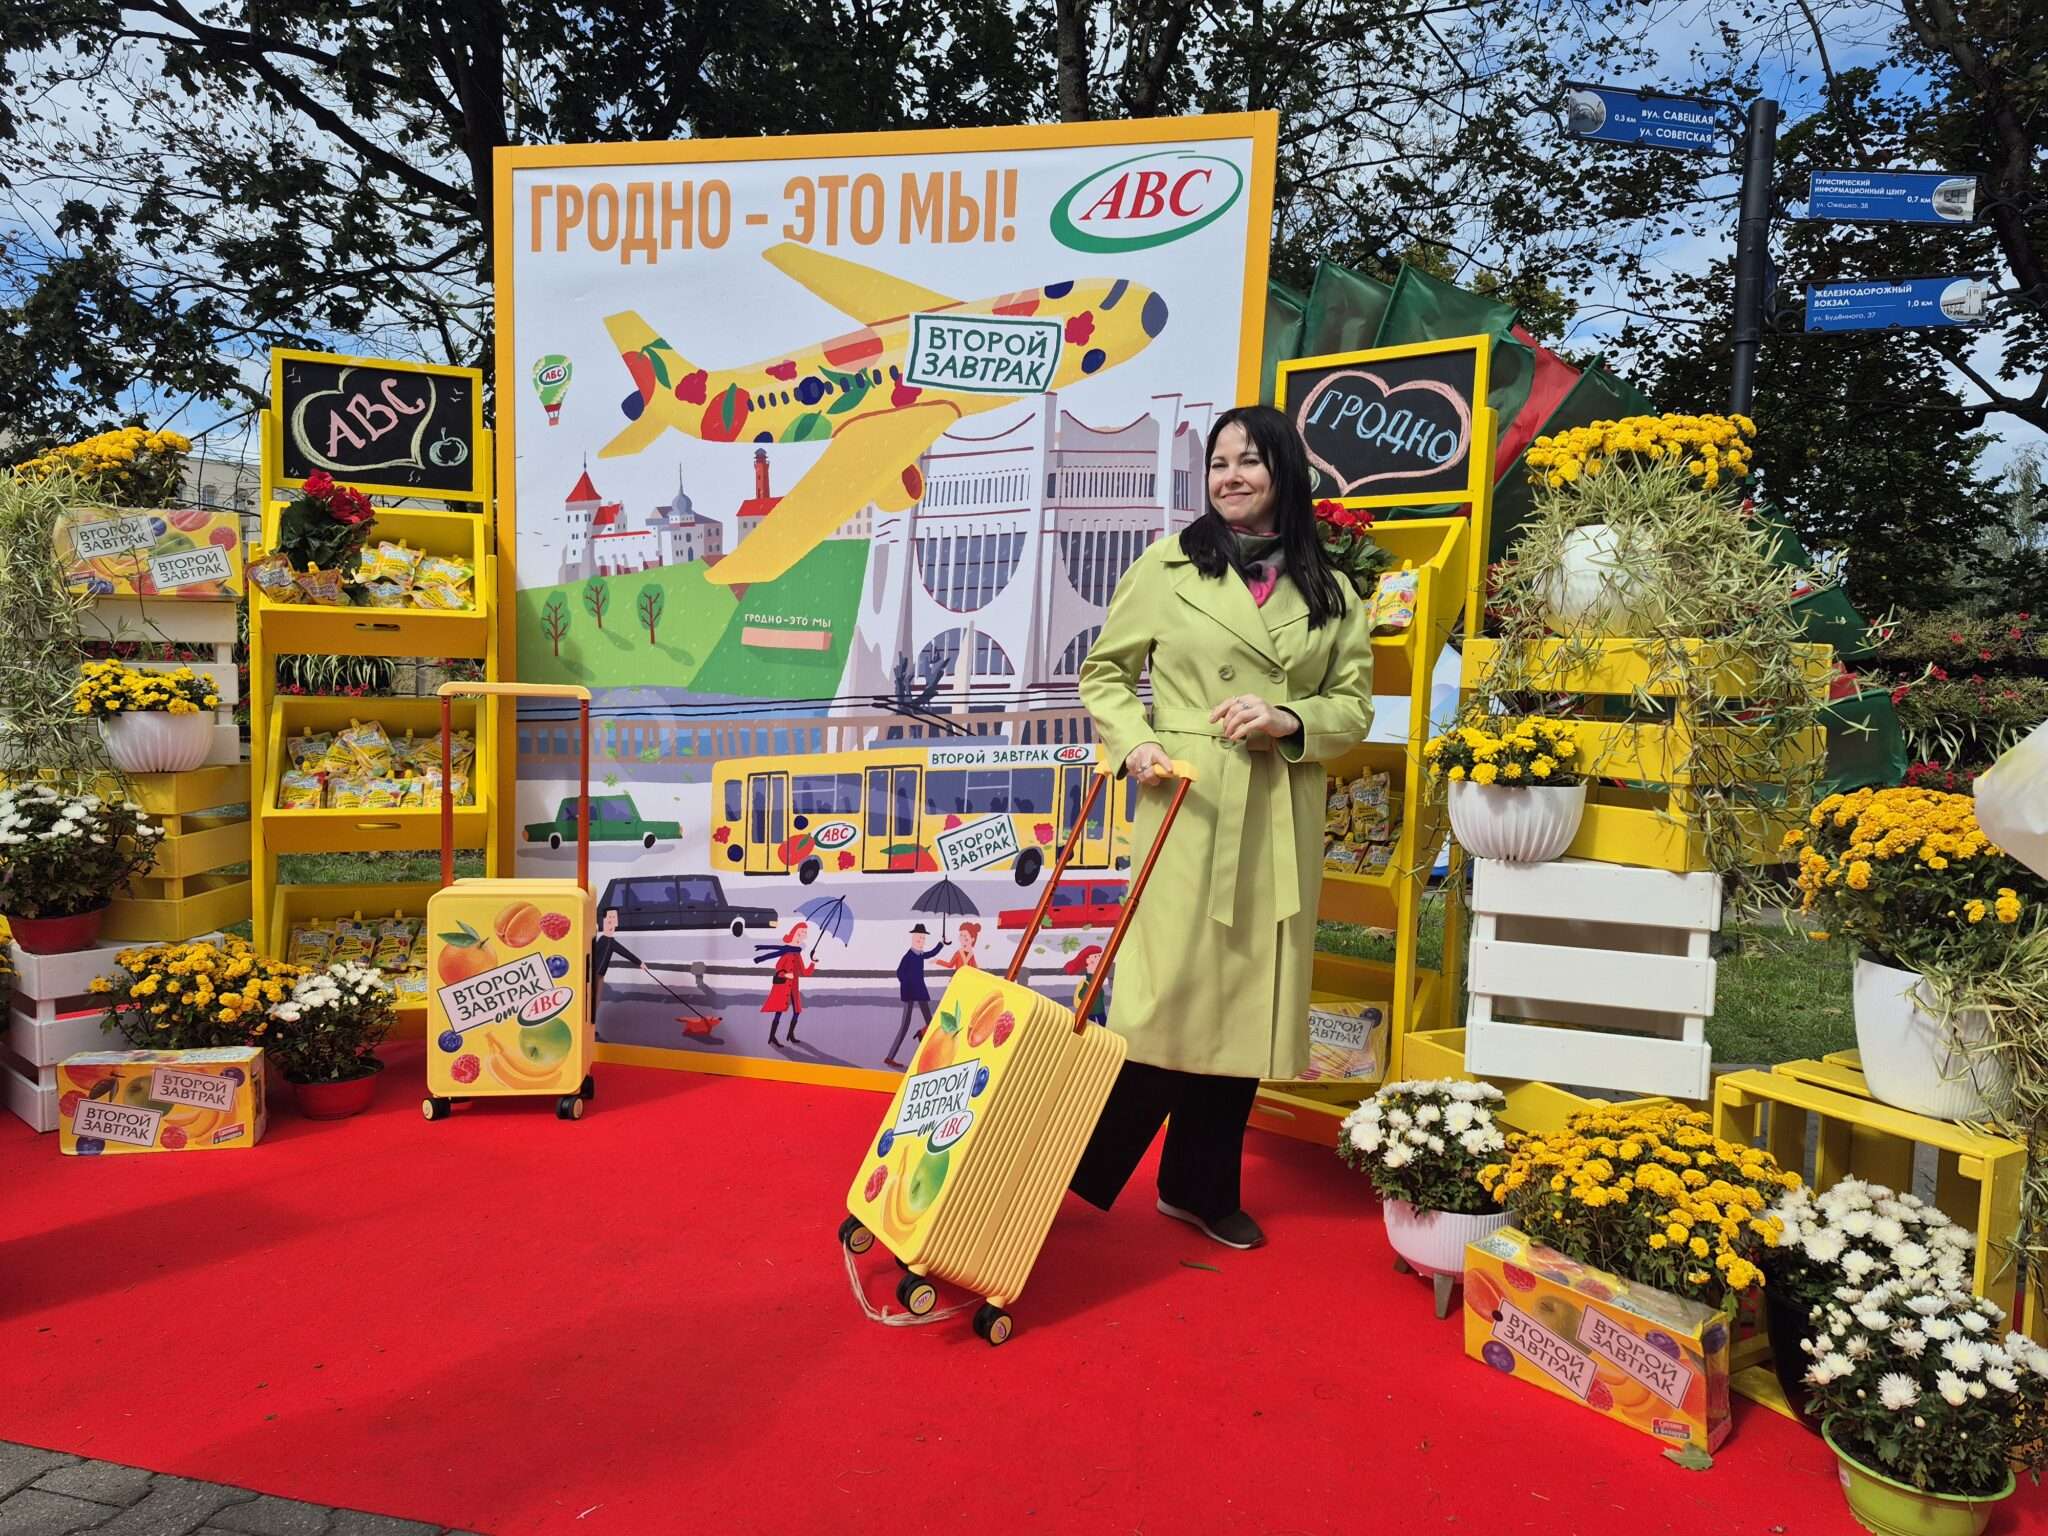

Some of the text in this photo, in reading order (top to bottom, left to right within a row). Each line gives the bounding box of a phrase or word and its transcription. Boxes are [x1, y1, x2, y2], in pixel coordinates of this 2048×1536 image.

[1641, 109, 1714, 124] вул. САВЕЦКАЯ
[1639, 127, 1712, 143] ул. СОВЕТСКАЯ
[1814, 186, 1906, 196] ИНФОРМАЦИОННЫЙ ЦЕНТР
[1815, 178, 1871, 187] ТУРИСТИЧЕСКИЙ
[1906, 196, 1919, 204] 0,7
[530, 178, 730, 265] ГРОДНО
[782, 171, 885, 246] ЭТО
[900, 168, 1018, 245] МЫ!
[1814, 285, 1912, 298] ЖЕЛЕЗНОДОРОЖНЫЙ
[1813, 299, 1850, 308] ВОКЗАЛ
[1907, 299, 1920, 308] 1,0
[929, 325, 1050, 358] ВТОРОЙ
[921, 353, 1045, 386] ЗАВТРАК
[1307, 389, 1458, 463] ГРОДНО
[79, 518, 141, 542] ВТОРОЙ
[82, 532, 149, 553] ЗАВТРАК
[158, 551, 219, 573] ВТОРОЙ
[161, 563, 225, 584] ЗАВТРАК
[812, 618, 832, 628] МЫ
[931, 750, 985, 765] ВТОРОЙ
[992, 749, 1049, 763] ЗАВТРАК
[948, 821, 1007, 856] ВТОРОЙ
[951, 836, 1012, 871] ЗАВТРАК
[452, 959, 537, 1006] ВТОРОЙ
[457, 978, 547, 1022] ЗАВТРАК
[494, 1004, 520, 1024] от
[1308, 1015, 1364, 1034] ВТОРОЙ
[1310, 1028, 1361, 1044] АВТРАК
[163, 1074, 226, 1093] ВТОРОЙ
[911, 1066, 970, 1101] ВТОРОЙ
[159, 1085, 225, 1105] ЗАВТРАК
[86, 1107, 151, 1127] ВТОРОЙ
[903, 1092, 964, 1122] ЗАВТРАК
[81, 1119, 149, 1140] ЗАВТРАК
[1509, 1313, 1585, 1373] ВТОРОЙ
[1595, 1318, 1678, 1380] ВТОРОЙ
[1504, 1328, 1583, 1387] ЗАВТРАК
[1589, 1332, 1675, 1397] ЗАВТРАК
